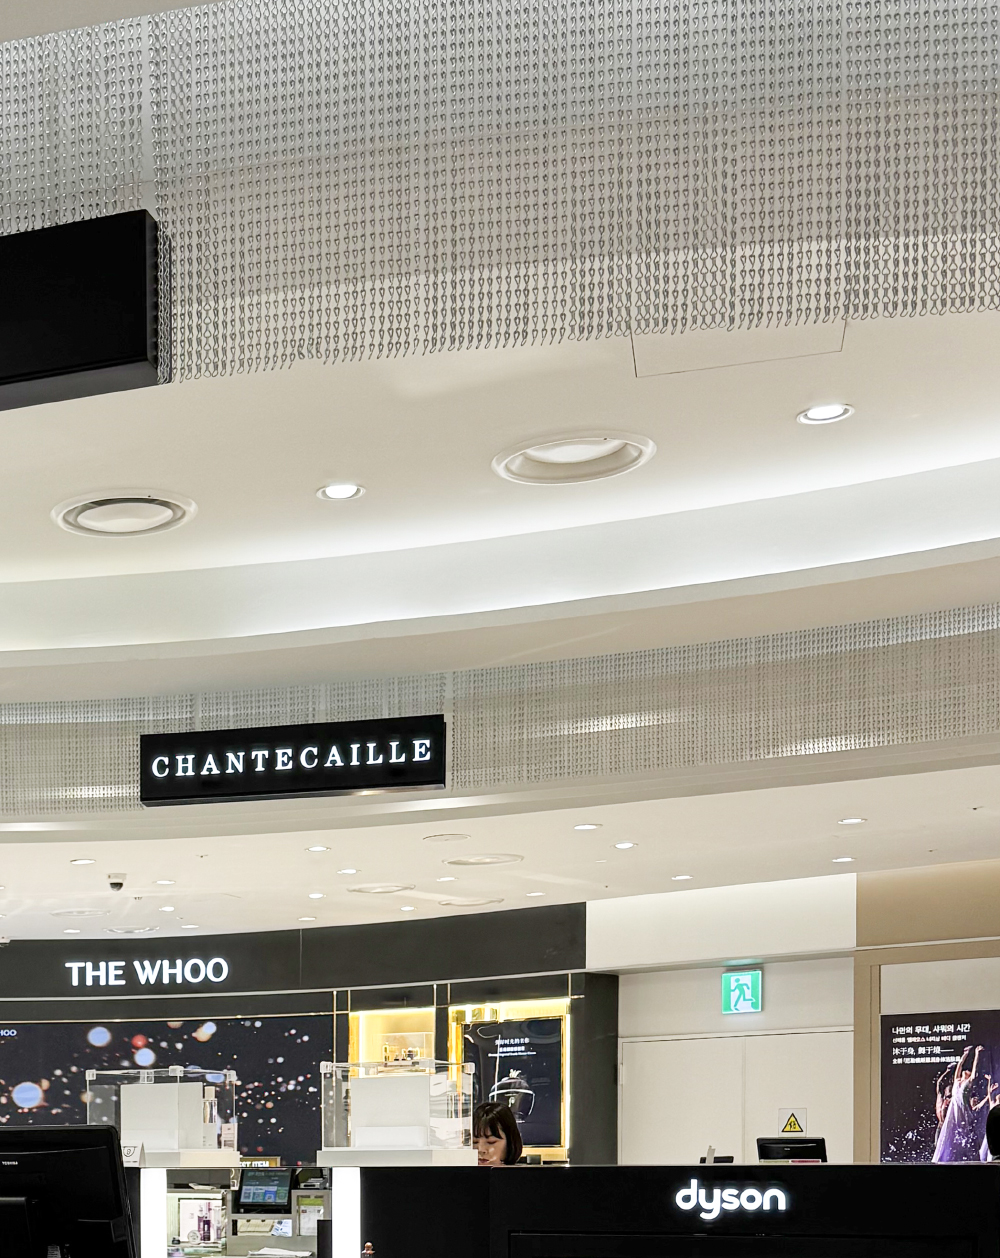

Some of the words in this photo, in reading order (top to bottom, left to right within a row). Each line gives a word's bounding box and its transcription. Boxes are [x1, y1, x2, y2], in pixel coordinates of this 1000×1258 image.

[151, 739, 431, 778] CHANTECAILLE
[64, 960, 127, 987] THE
[132, 957, 229, 985] WHOO
[675, 1178, 786, 1220] dyson
